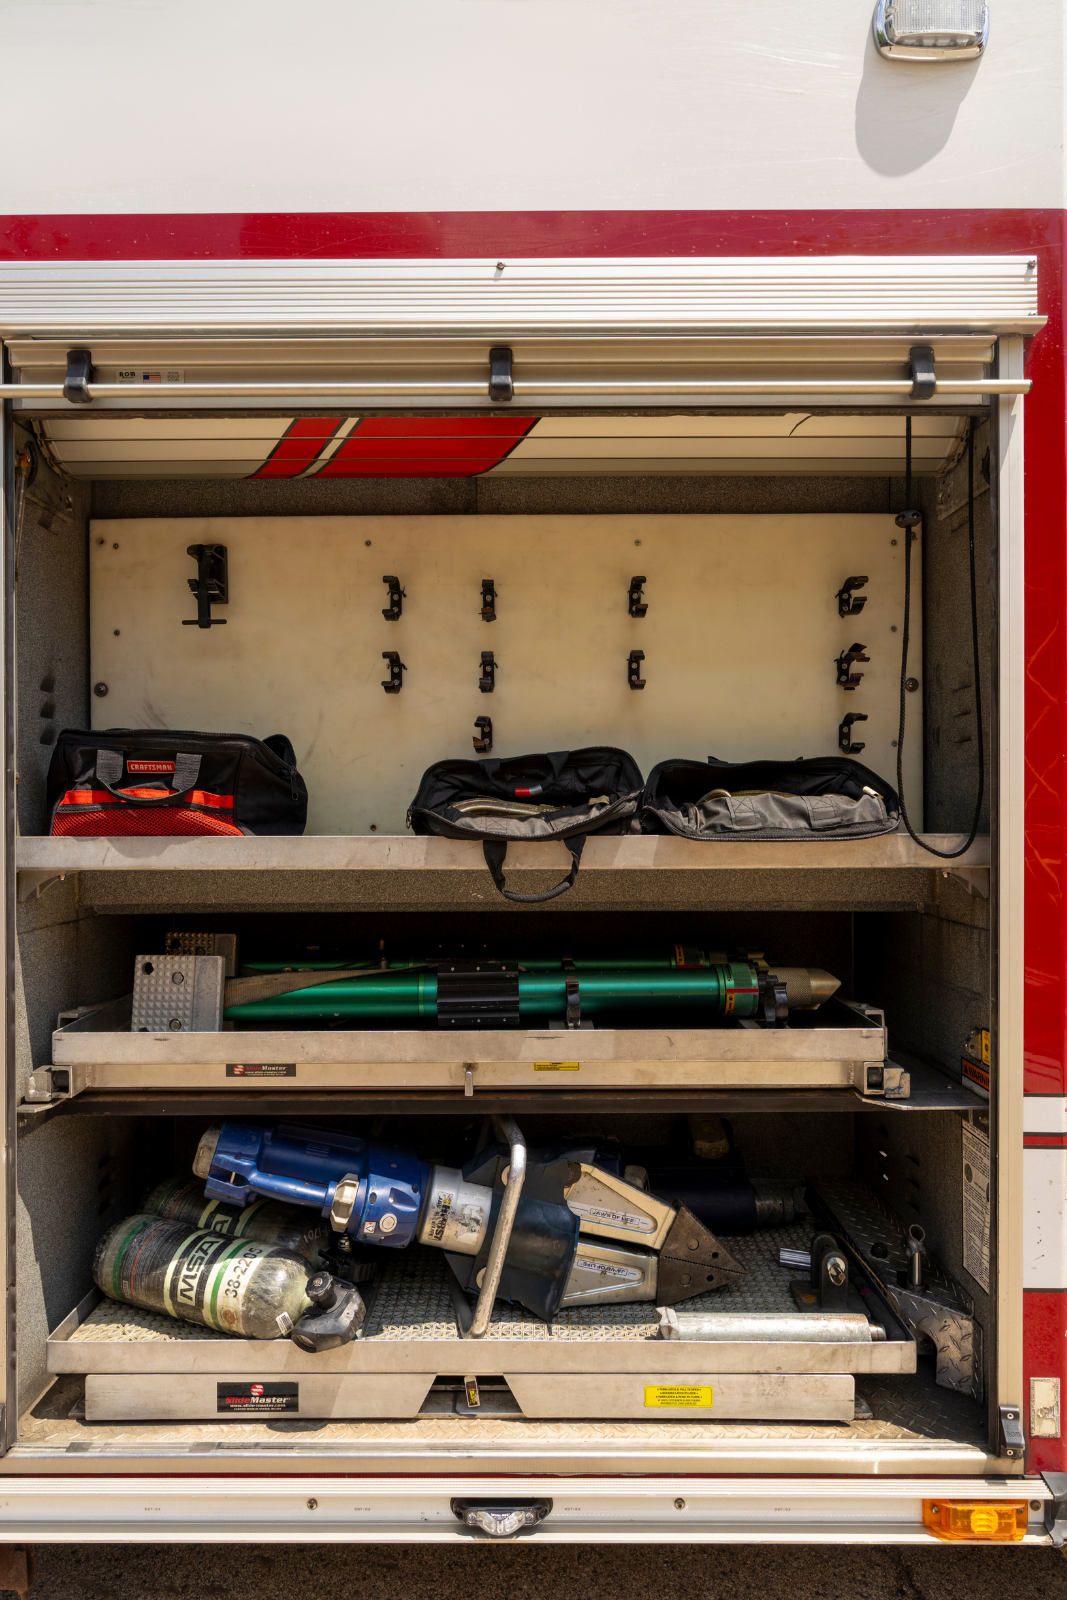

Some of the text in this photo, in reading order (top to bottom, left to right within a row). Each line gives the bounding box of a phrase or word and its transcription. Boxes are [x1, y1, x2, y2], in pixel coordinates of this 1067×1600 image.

[130, 763, 173, 771] CRAFTSMAN
[178, 1239, 218, 1301] MSA
[224, 1246, 263, 1299] 38-2205
[225, 1396, 288, 1404] SlideMaster
